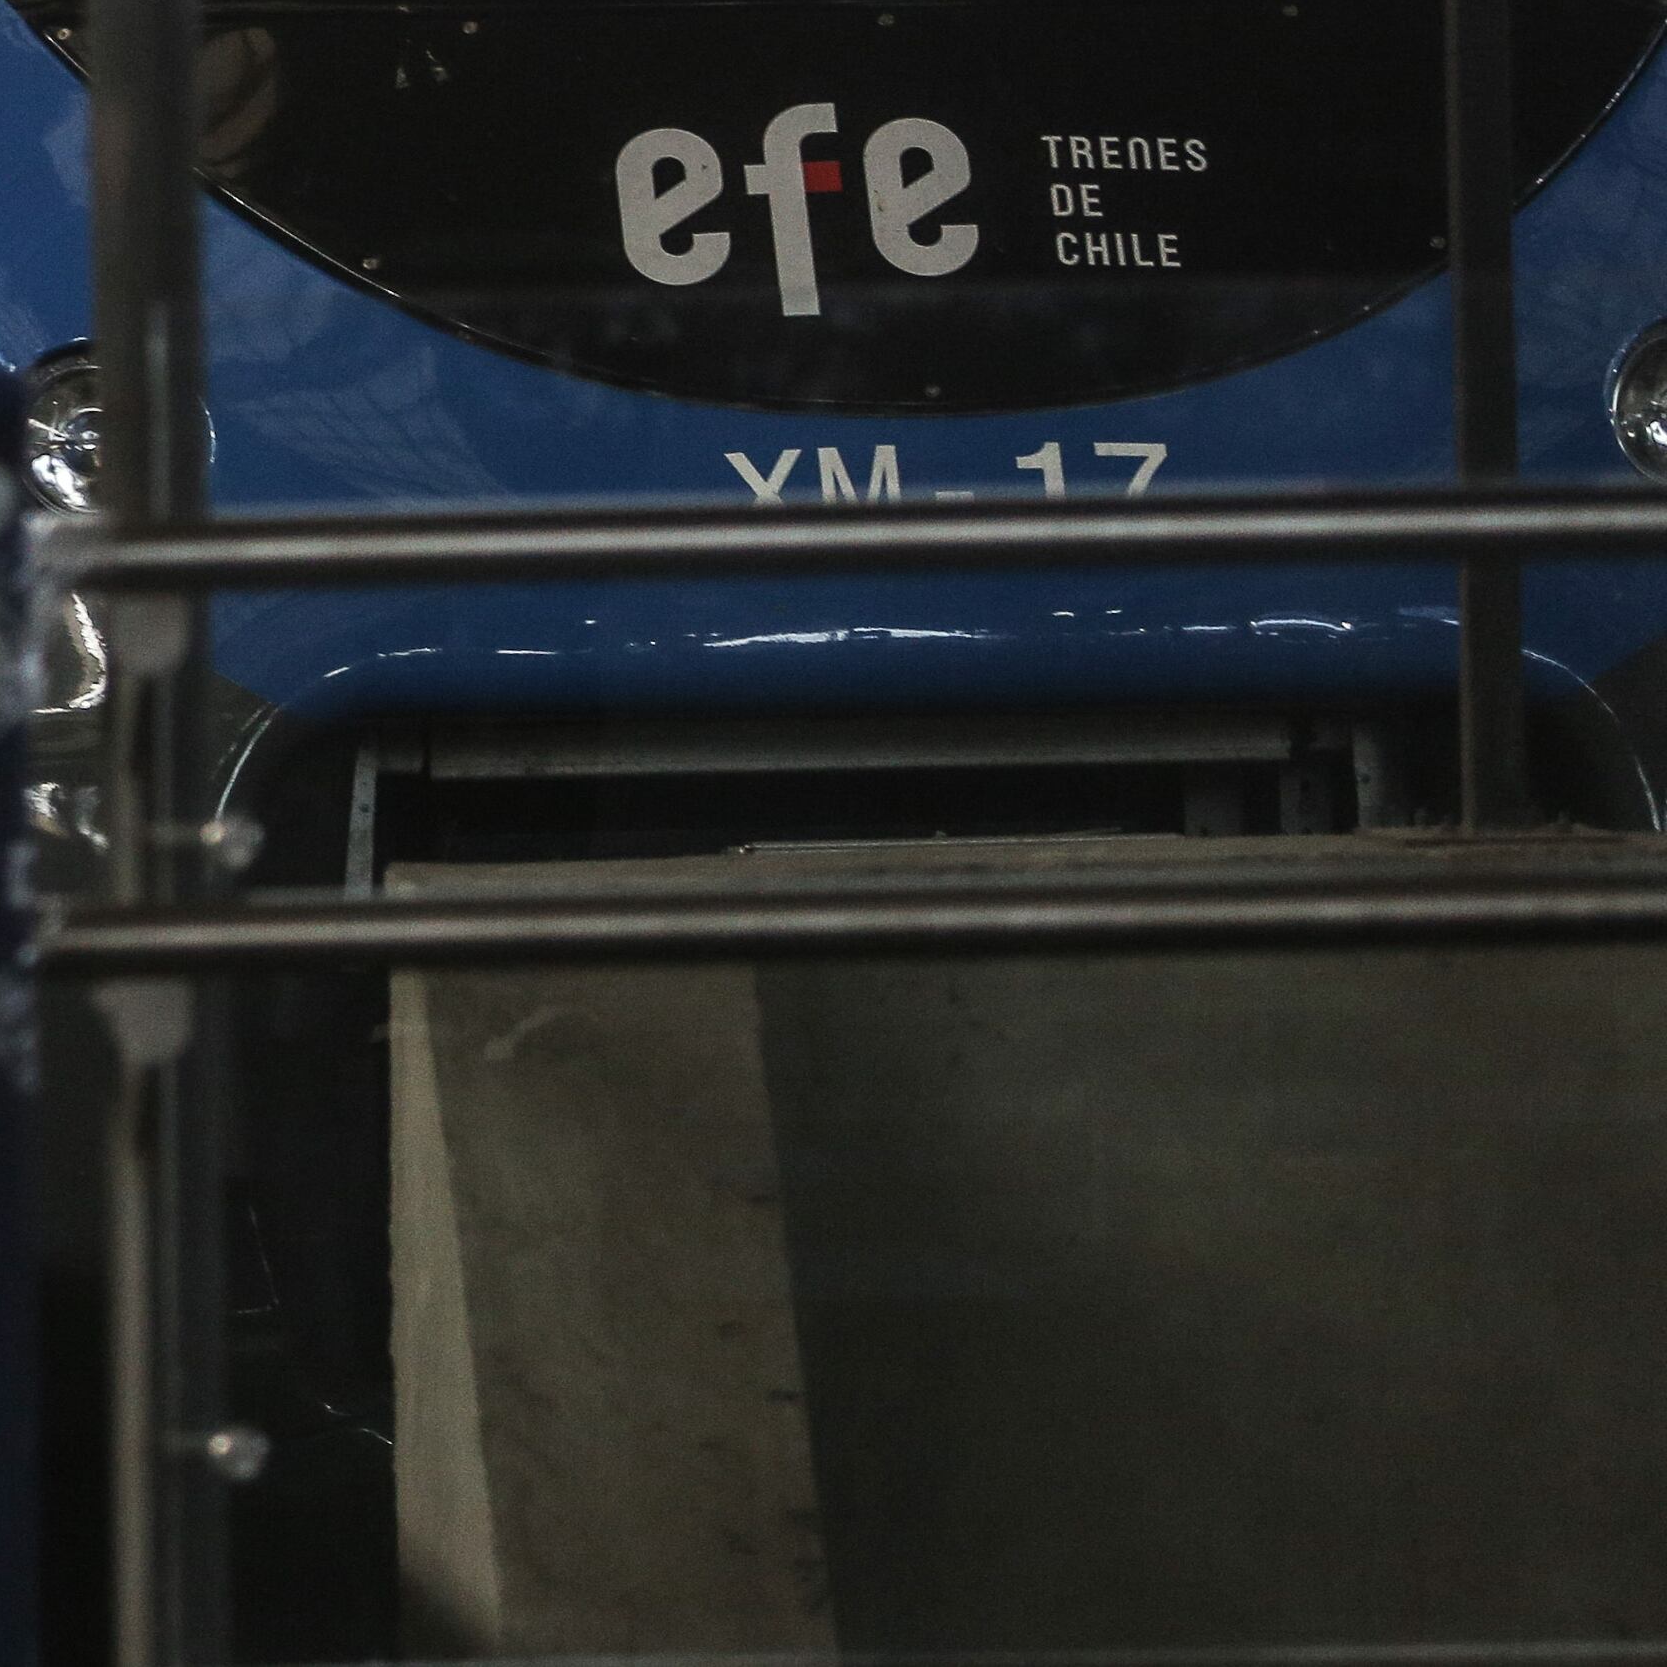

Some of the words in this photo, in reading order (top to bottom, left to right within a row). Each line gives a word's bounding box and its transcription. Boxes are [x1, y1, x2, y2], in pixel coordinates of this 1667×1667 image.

[615, 102, 979, 316] efe
[1051, 183, 1104, 218] DE
[1056, 232, 1183, 269] CHILE
